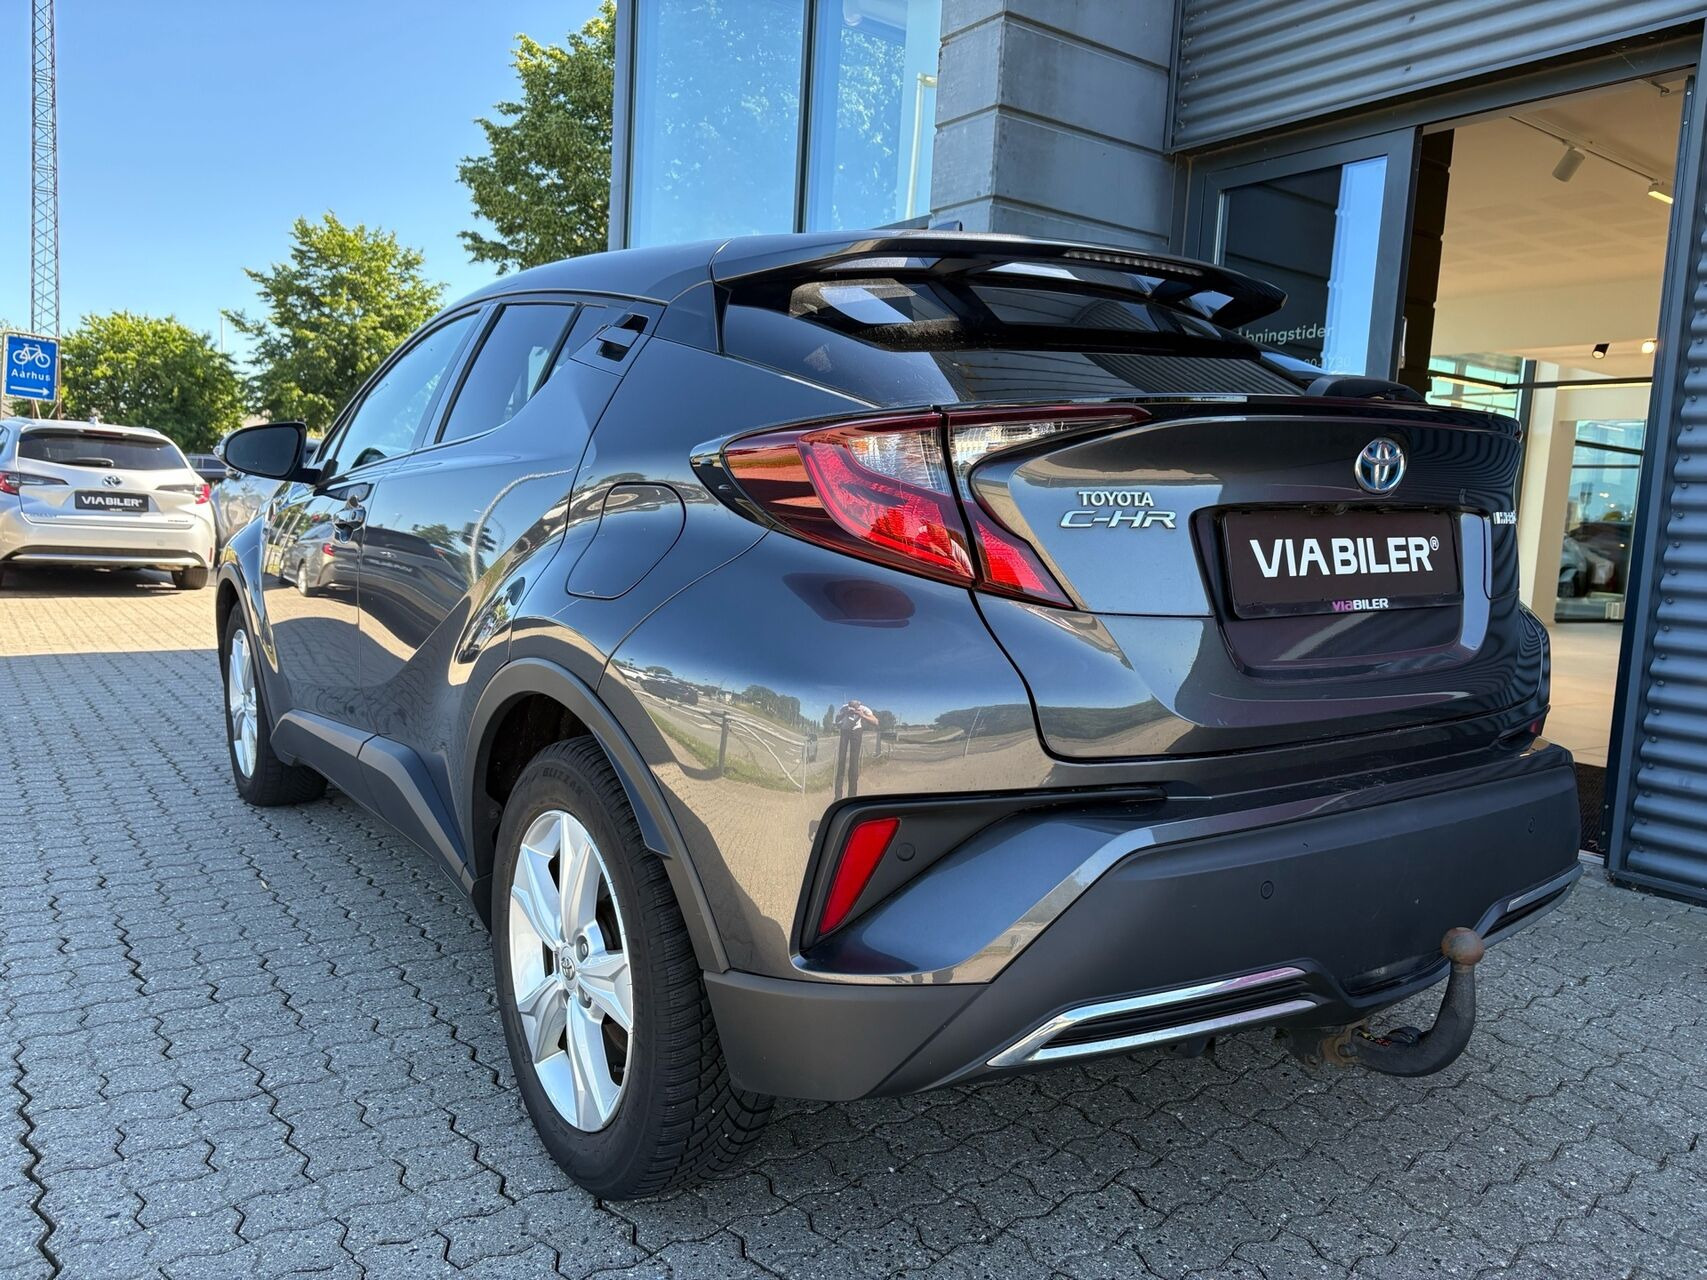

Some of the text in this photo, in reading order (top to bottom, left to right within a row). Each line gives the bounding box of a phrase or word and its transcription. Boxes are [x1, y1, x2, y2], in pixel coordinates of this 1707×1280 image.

[11, 368, 51, 382] Aarhus
[1078, 491, 1154, 507] TOYOTA
[1060, 510, 1176, 528] C-HR
